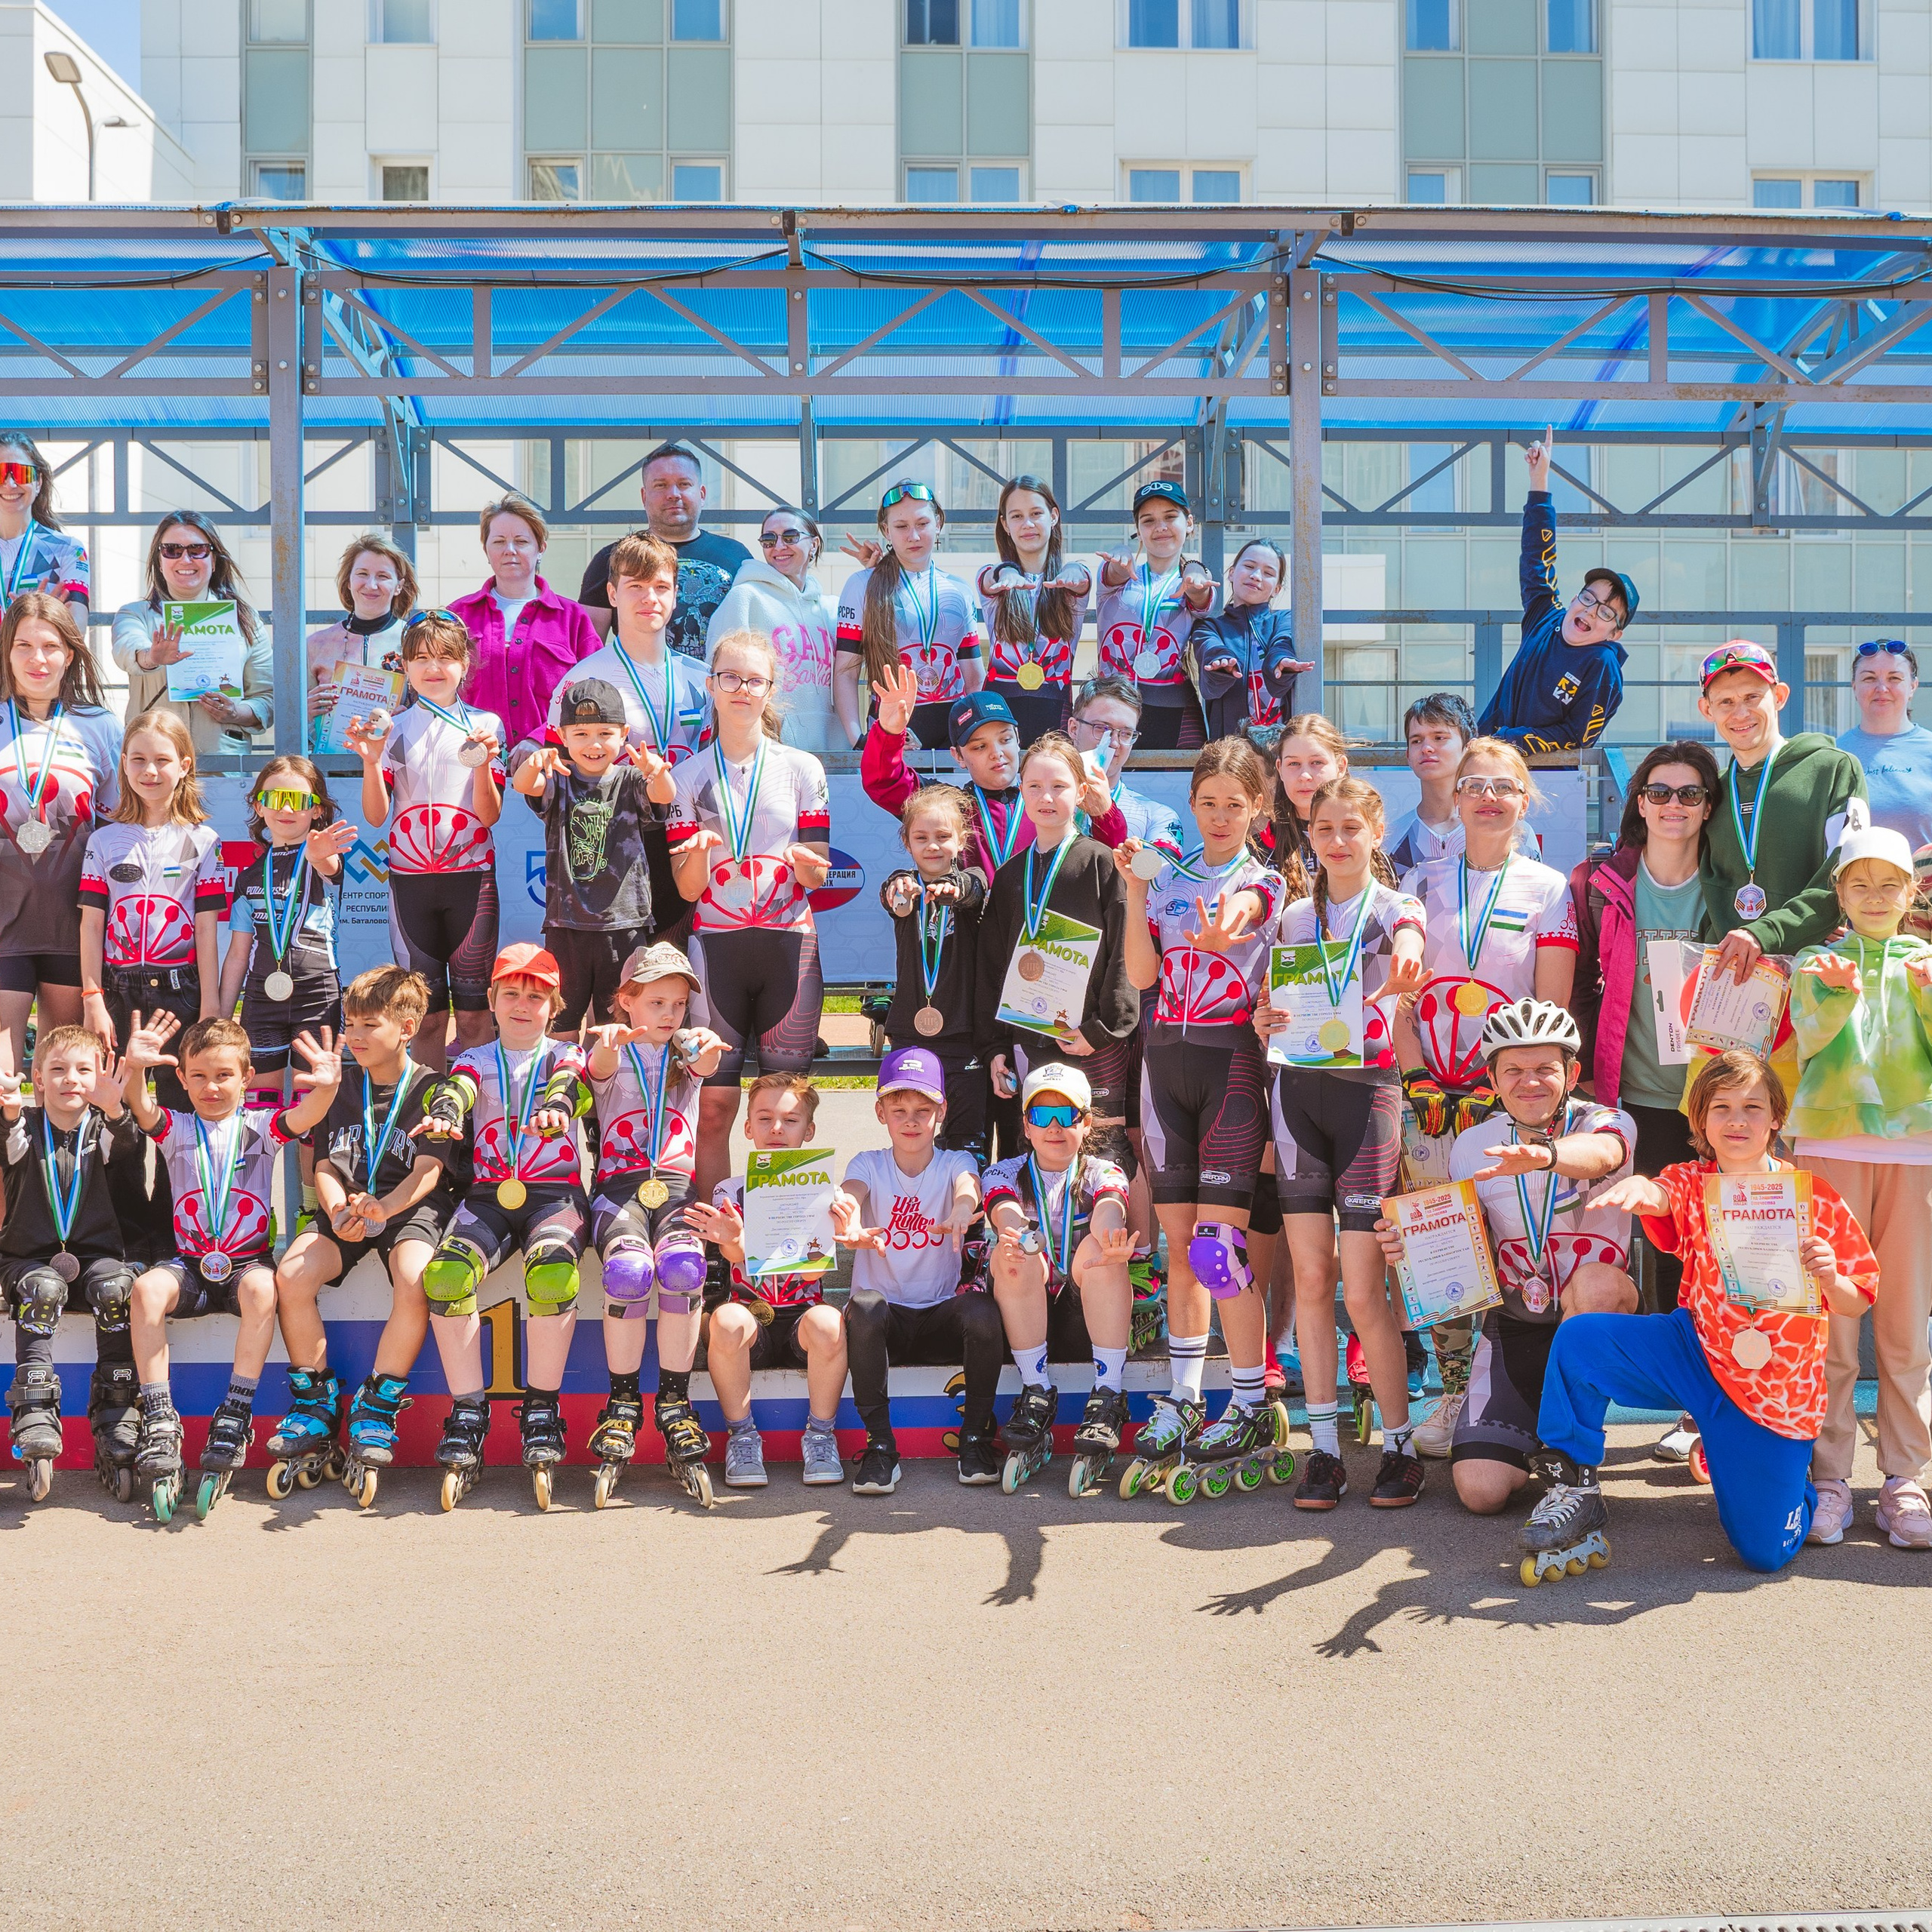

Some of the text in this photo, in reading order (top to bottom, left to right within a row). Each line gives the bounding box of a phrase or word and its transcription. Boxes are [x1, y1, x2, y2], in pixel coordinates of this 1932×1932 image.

[838, 605, 855, 620] РСРБ
[183, 625, 235, 635] АМОТА
[340, 686, 388, 704] ГРАМОТА
[82, 1143, 97, 1157] PUMA
[748, 1171, 830, 1189] ГРАМОТА
[1751, 1183, 1783, 1191] 1945-2025
[1423, 1193, 1451, 1205] 1945-2025
[1722, 1208, 1795, 1221] ГРАМОТА
[1402, 1213, 1466, 1237] ГРАМОТА
[478, 1297, 528, 1401] 1
